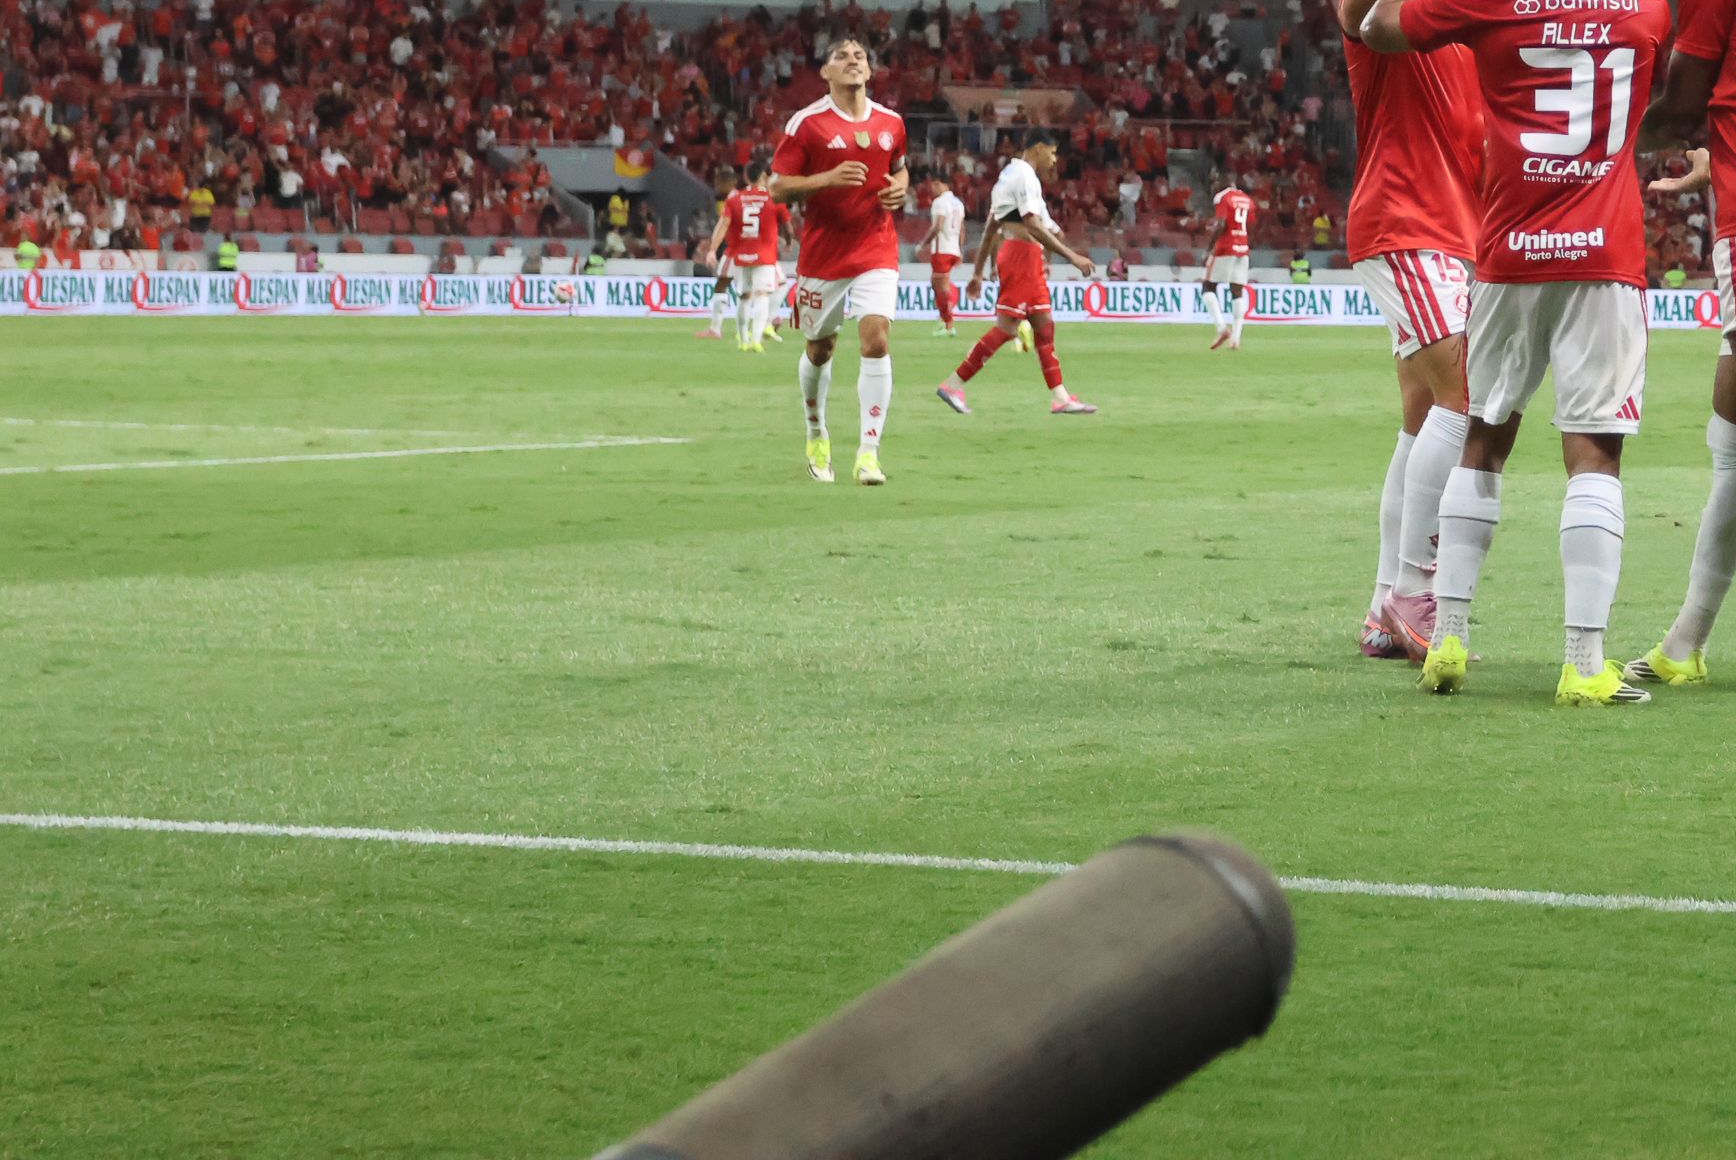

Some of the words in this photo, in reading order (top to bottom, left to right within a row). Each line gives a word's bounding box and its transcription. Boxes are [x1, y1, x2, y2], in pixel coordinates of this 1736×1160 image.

[1541, 22, 1613, 46] ALLEX
[1519, 48, 1636, 156] 31
[1523, 157, 1615, 177] CIGAME
[741, 204, 761, 239] 5
[1234, 207, 1249, 232] 4
[1508, 227, 1604, 251] Unimed
[1524, 250, 1551, 261] Porto
[1554, 248, 1588, 261] Alegre
[1431, 253, 1467, 283] 15
[104, 271, 201, 310] MARQUESPAN
[208, 272, 300, 310] MARQUESPAN
[305, 273, 392, 310] MARQUESPAN
[399, 273, 480, 310] MARQUESPAN
[606, 275, 738, 312] MARQUESPN
